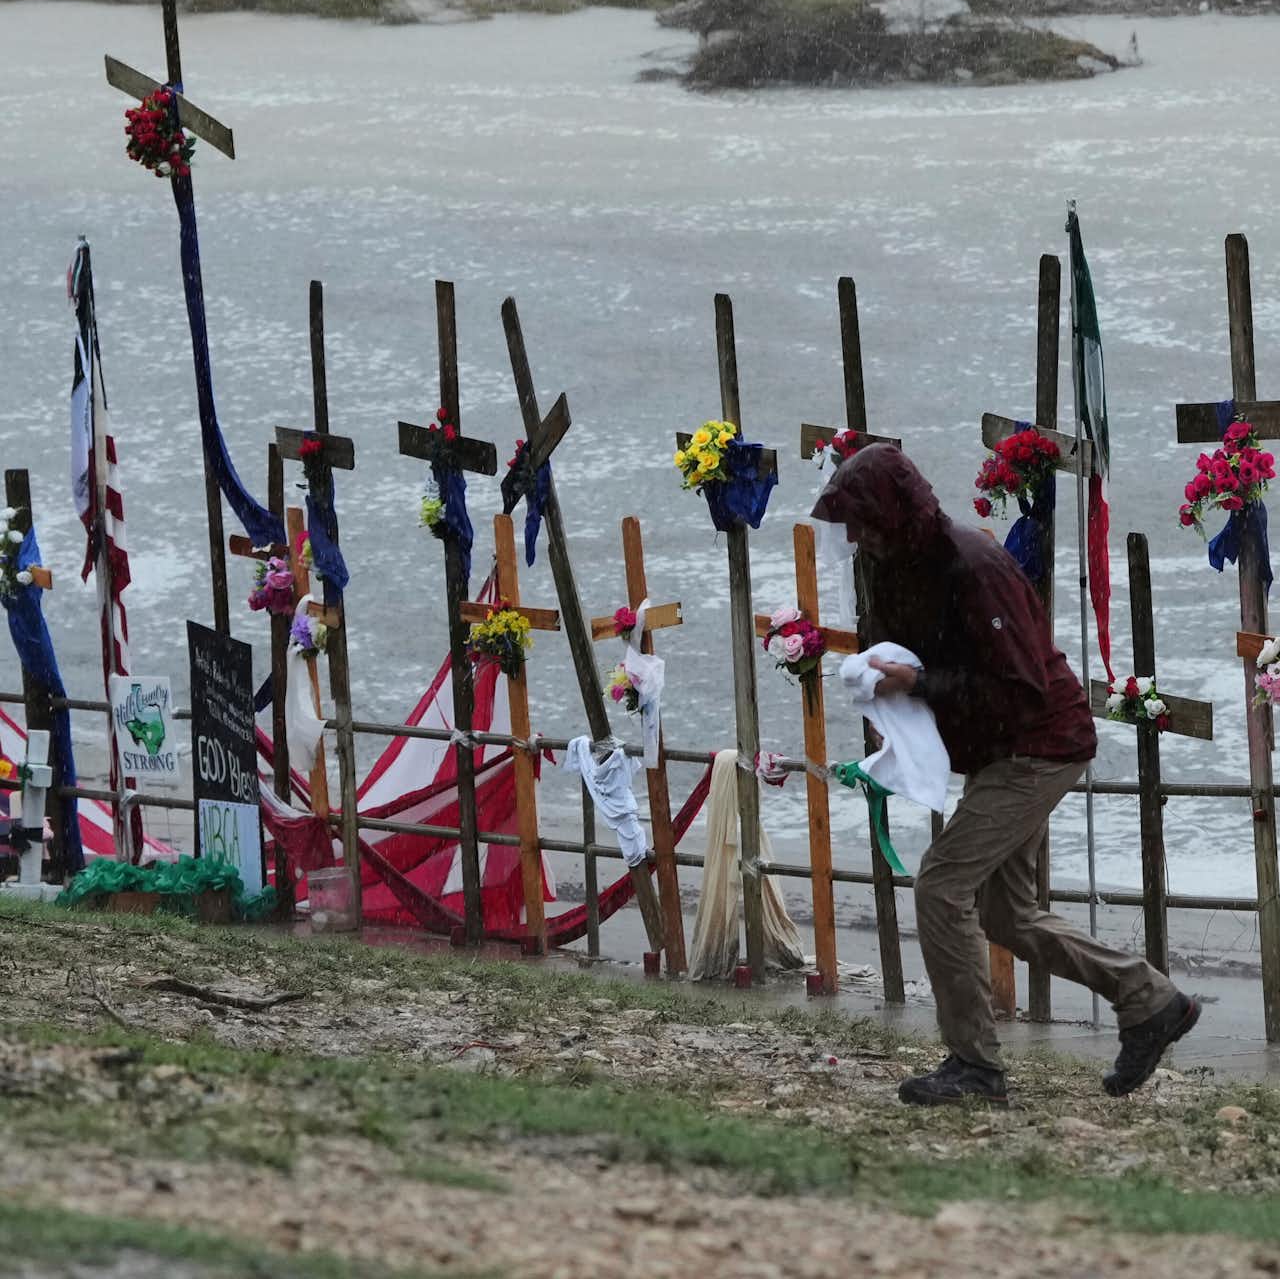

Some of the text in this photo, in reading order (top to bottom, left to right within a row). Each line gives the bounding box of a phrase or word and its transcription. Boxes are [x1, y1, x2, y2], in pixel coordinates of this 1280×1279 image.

[114, 692, 136, 731] Hill
[135, 684, 169, 713] Country
[123, 751, 175, 771] STRONG
[198, 735, 226, 783] GOD
